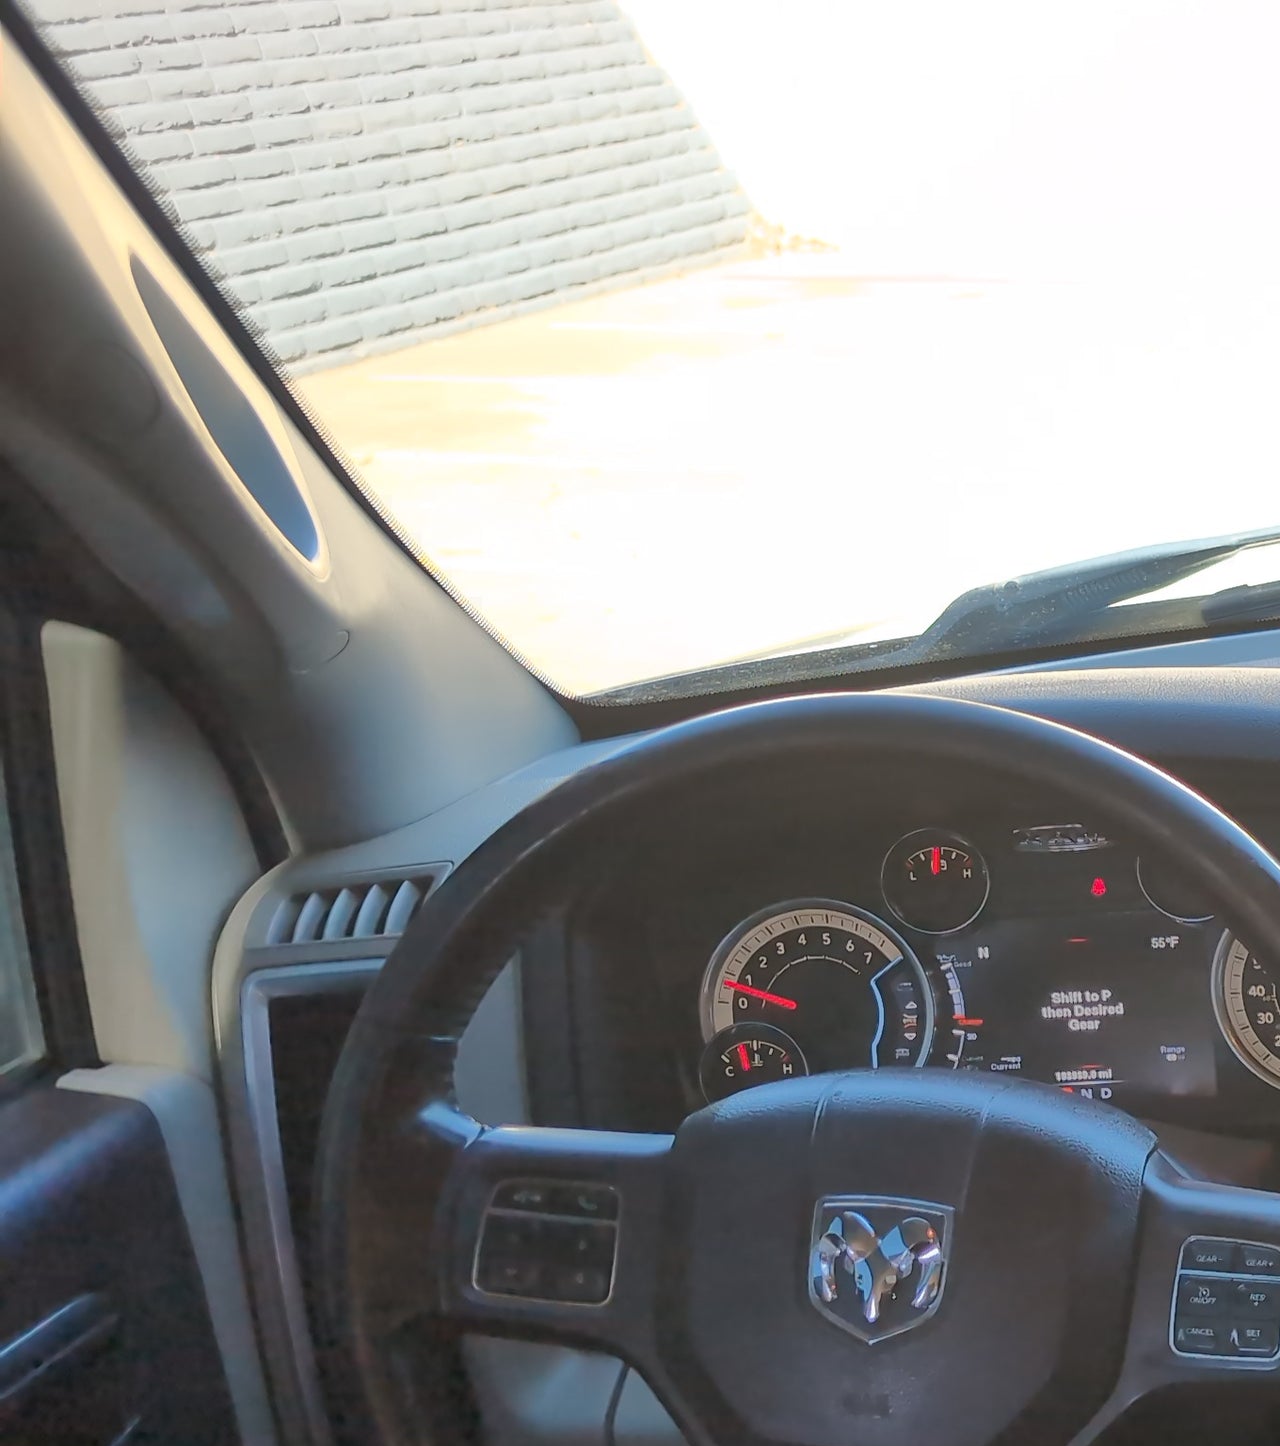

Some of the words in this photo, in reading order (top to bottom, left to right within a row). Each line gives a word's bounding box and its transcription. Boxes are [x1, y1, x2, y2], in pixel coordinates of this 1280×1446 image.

[910, 871, 917, 880] L
[963, 868, 971, 878] H
[798, 933, 807, 945] 4
[823, 933, 831, 945] 5
[1151, 935, 1179, 949] 55°F
[776, 942, 785, 955] 3
[846, 939, 855, 952] 6
[864, 952, 873, 964] 7
[977, 946, 989, 959] N
[759, 956, 768, 968] 2
[745, 974, 752, 985] 1
[1084, 990, 1100, 1002] to
[1101, 989, 1112, 1001] P
[1248, 985, 1265, 997] 40
[738, 997, 748, 1009] 0
[1041, 1006, 1072, 1018] then
[1073, 1002, 1124, 1017] Desired
[1257, 1012, 1274, 1024] 30
[1067, 1018, 1101, 1031] Gear
[725, 1066, 734, 1077] C
[783, 1063, 792, 1074] H
[1100, 1087, 1112, 1099] D
[1186, 1327, 1214, 1336] CANCEL
[1246, 1329, 1261, 1337] SET
